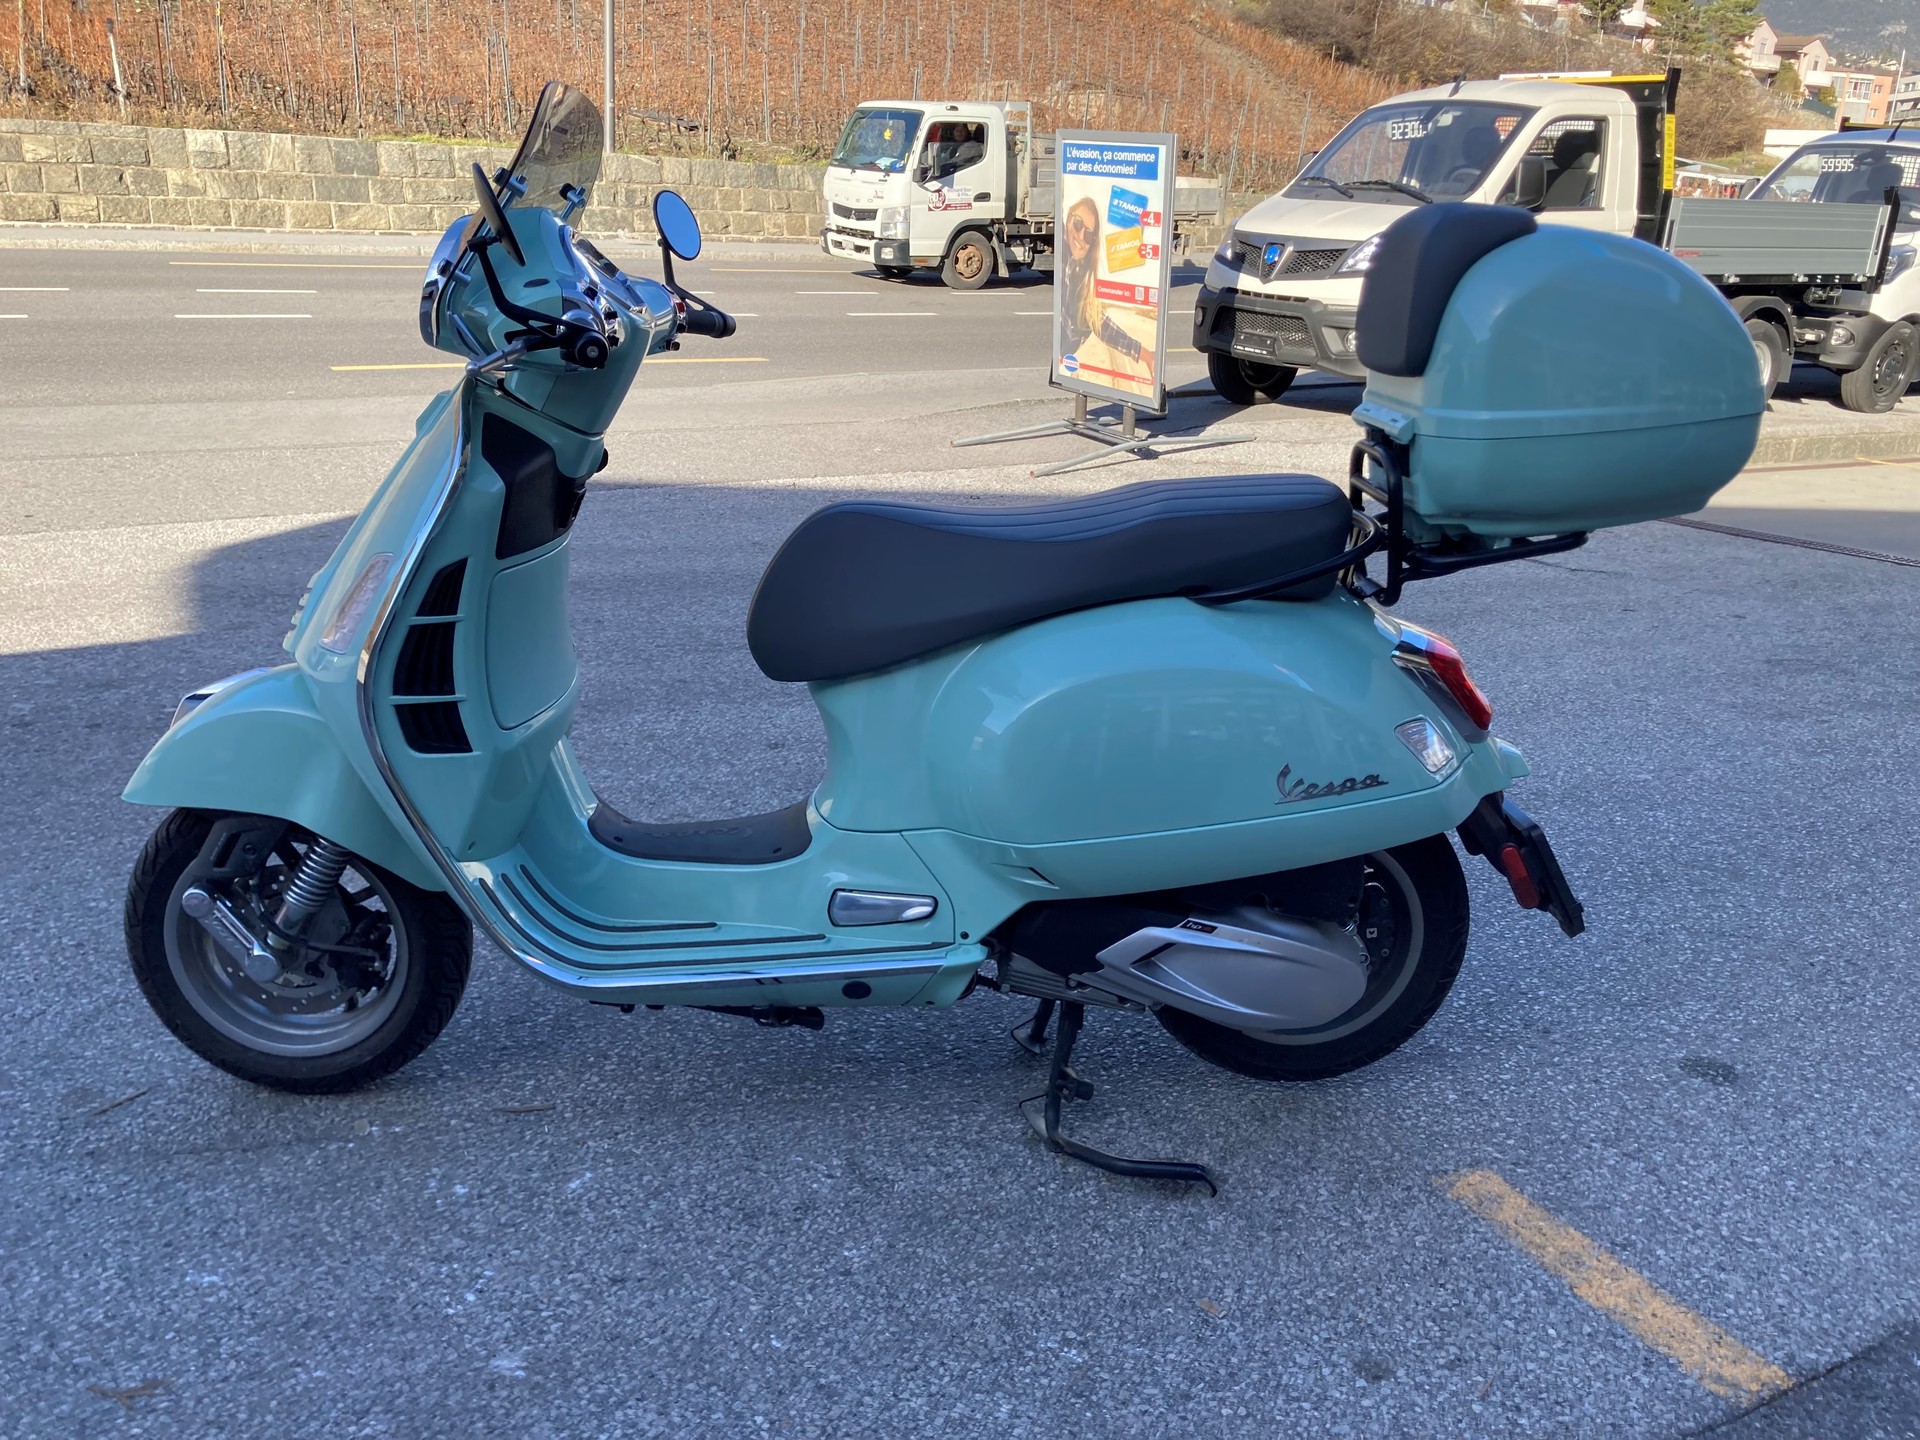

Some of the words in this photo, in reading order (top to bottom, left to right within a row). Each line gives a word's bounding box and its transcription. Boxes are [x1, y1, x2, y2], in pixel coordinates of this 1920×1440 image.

[1066, 146, 1102, 161] L'évasion,
[1103, 150, 1113, 162] ça
[1113, 151, 1155, 163] commence
[1066, 161, 1078, 172] par
[1078, 160, 1092, 172] des
[1275, 763, 1389, 805] Vespa
